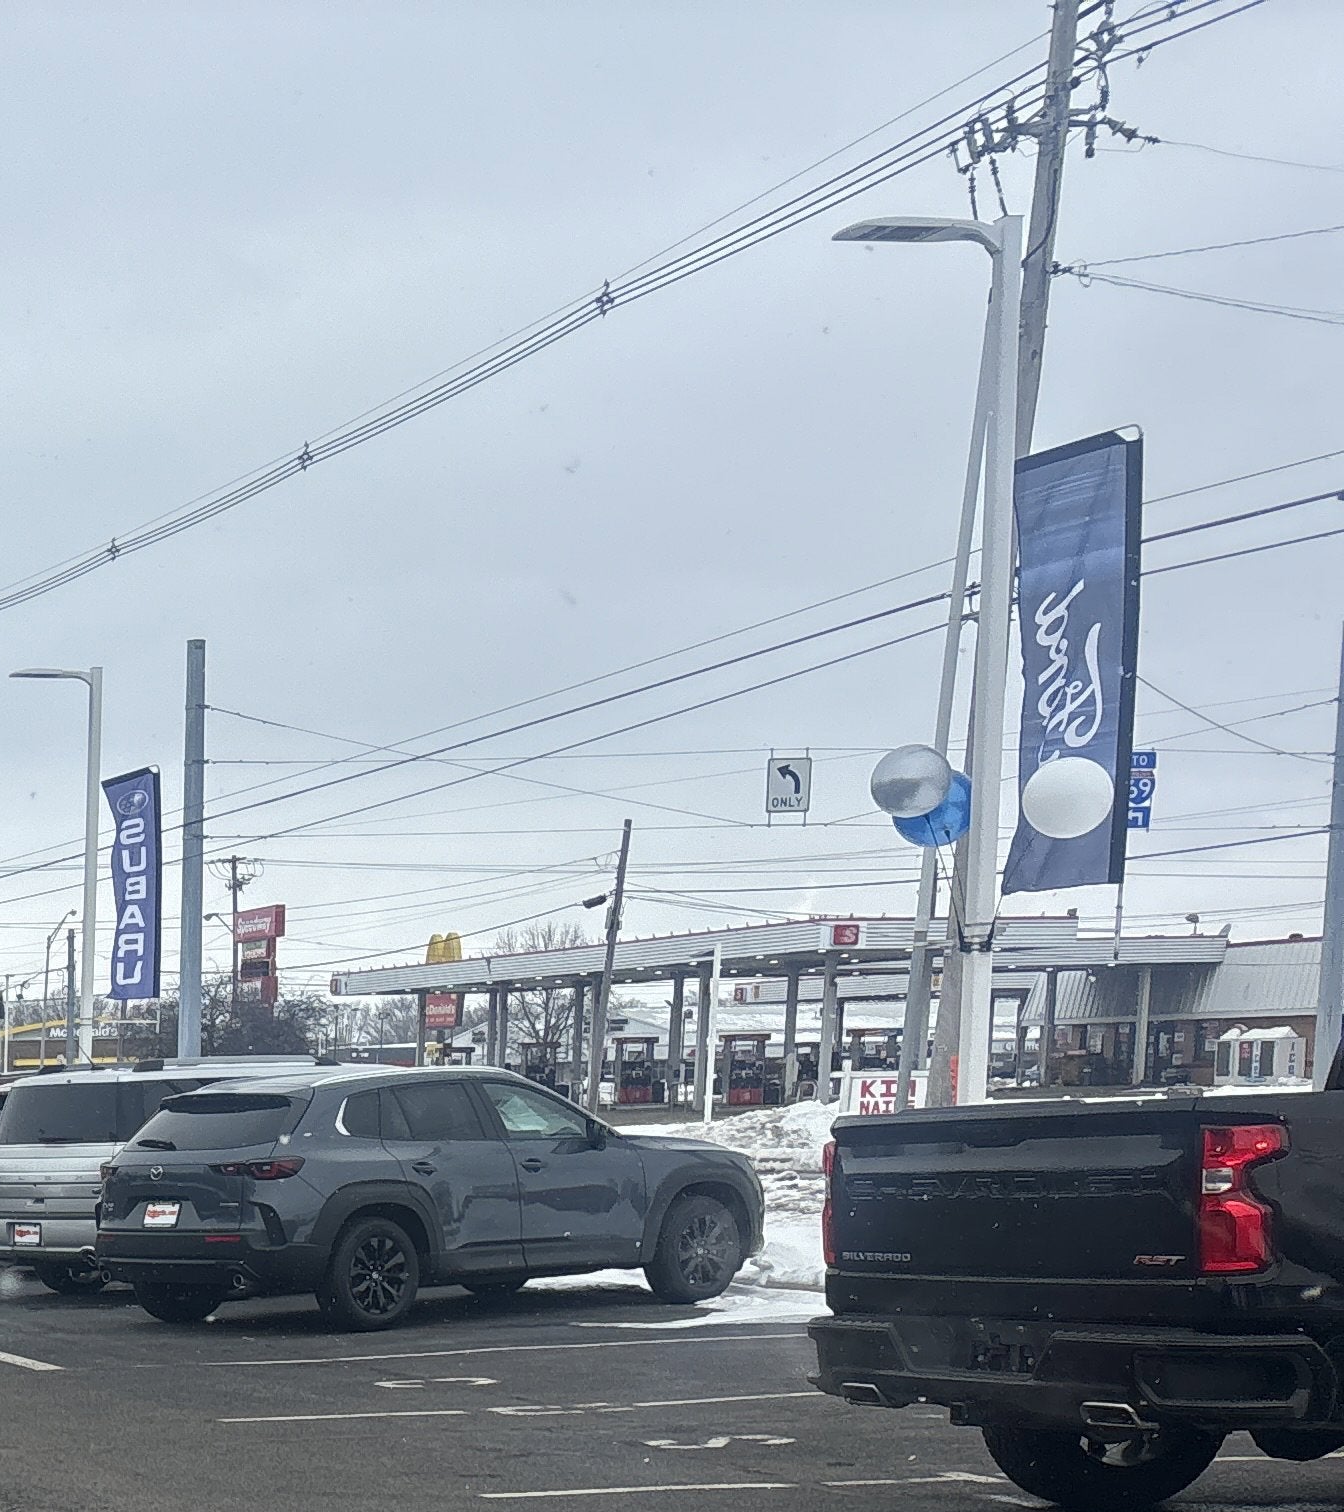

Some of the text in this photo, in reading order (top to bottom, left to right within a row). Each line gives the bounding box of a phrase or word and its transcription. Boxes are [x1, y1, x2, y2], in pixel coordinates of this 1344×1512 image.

[1132, 755, 1148, 766] TO
[771, 796, 803, 808] ONLY
[842, 1252, 911, 1262] SILVERADO
[1133, 1255, 1186, 1266] RST
